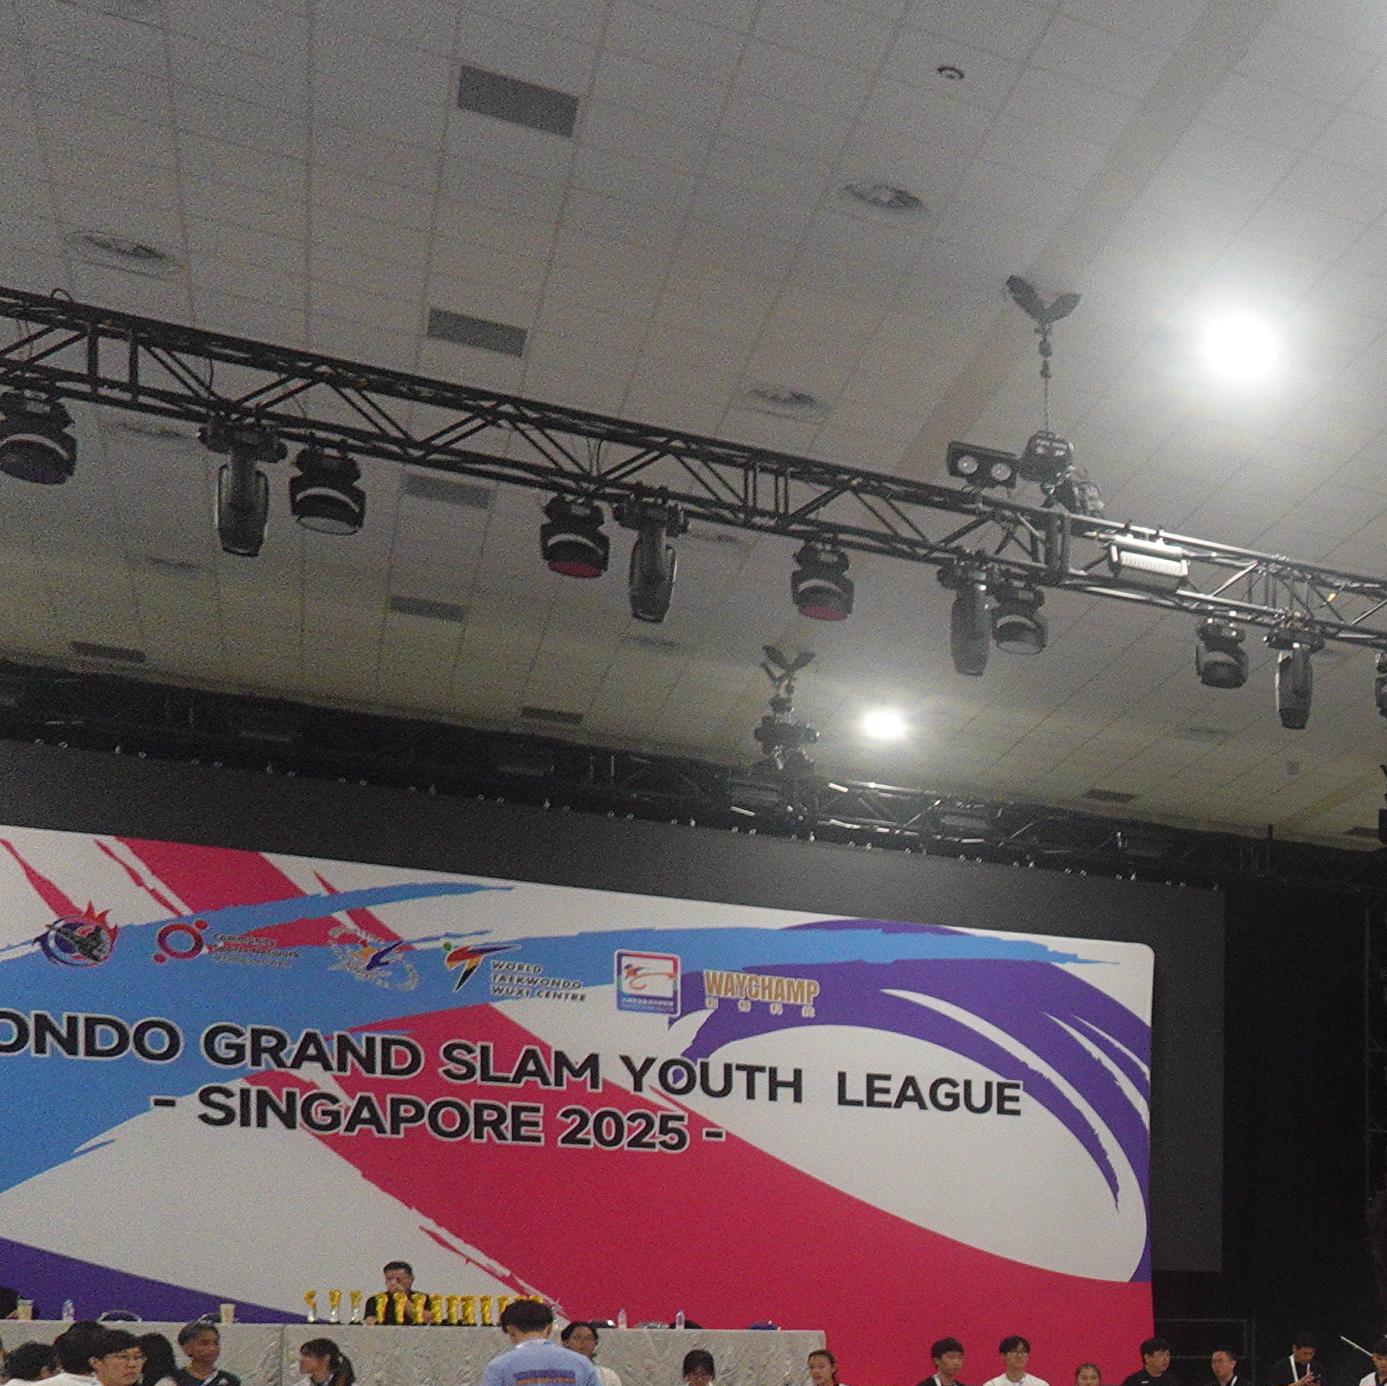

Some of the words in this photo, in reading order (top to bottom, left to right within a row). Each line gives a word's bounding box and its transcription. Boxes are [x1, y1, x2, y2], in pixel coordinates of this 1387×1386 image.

[492, 960, 542, 974] WORLD
[492, 974, 583, 990] TAEKWONDO
[492, 985, 531, 998] WUXI
[536, 989, 587, 1002] CENTRE
[704, 970, 820, 1005] WAYCHAMP
[202, 1023, 423, 1078] GRAND
[442, 1039, 602, 1091] SLAM
[619, 1054, 803, 1104] YOUTH
[836, 1071, 1022, 1117] LEAGUE
[197, 1085, 545, 1144] SINGAPORE
[558, 1108, 689, 1153] 2025
